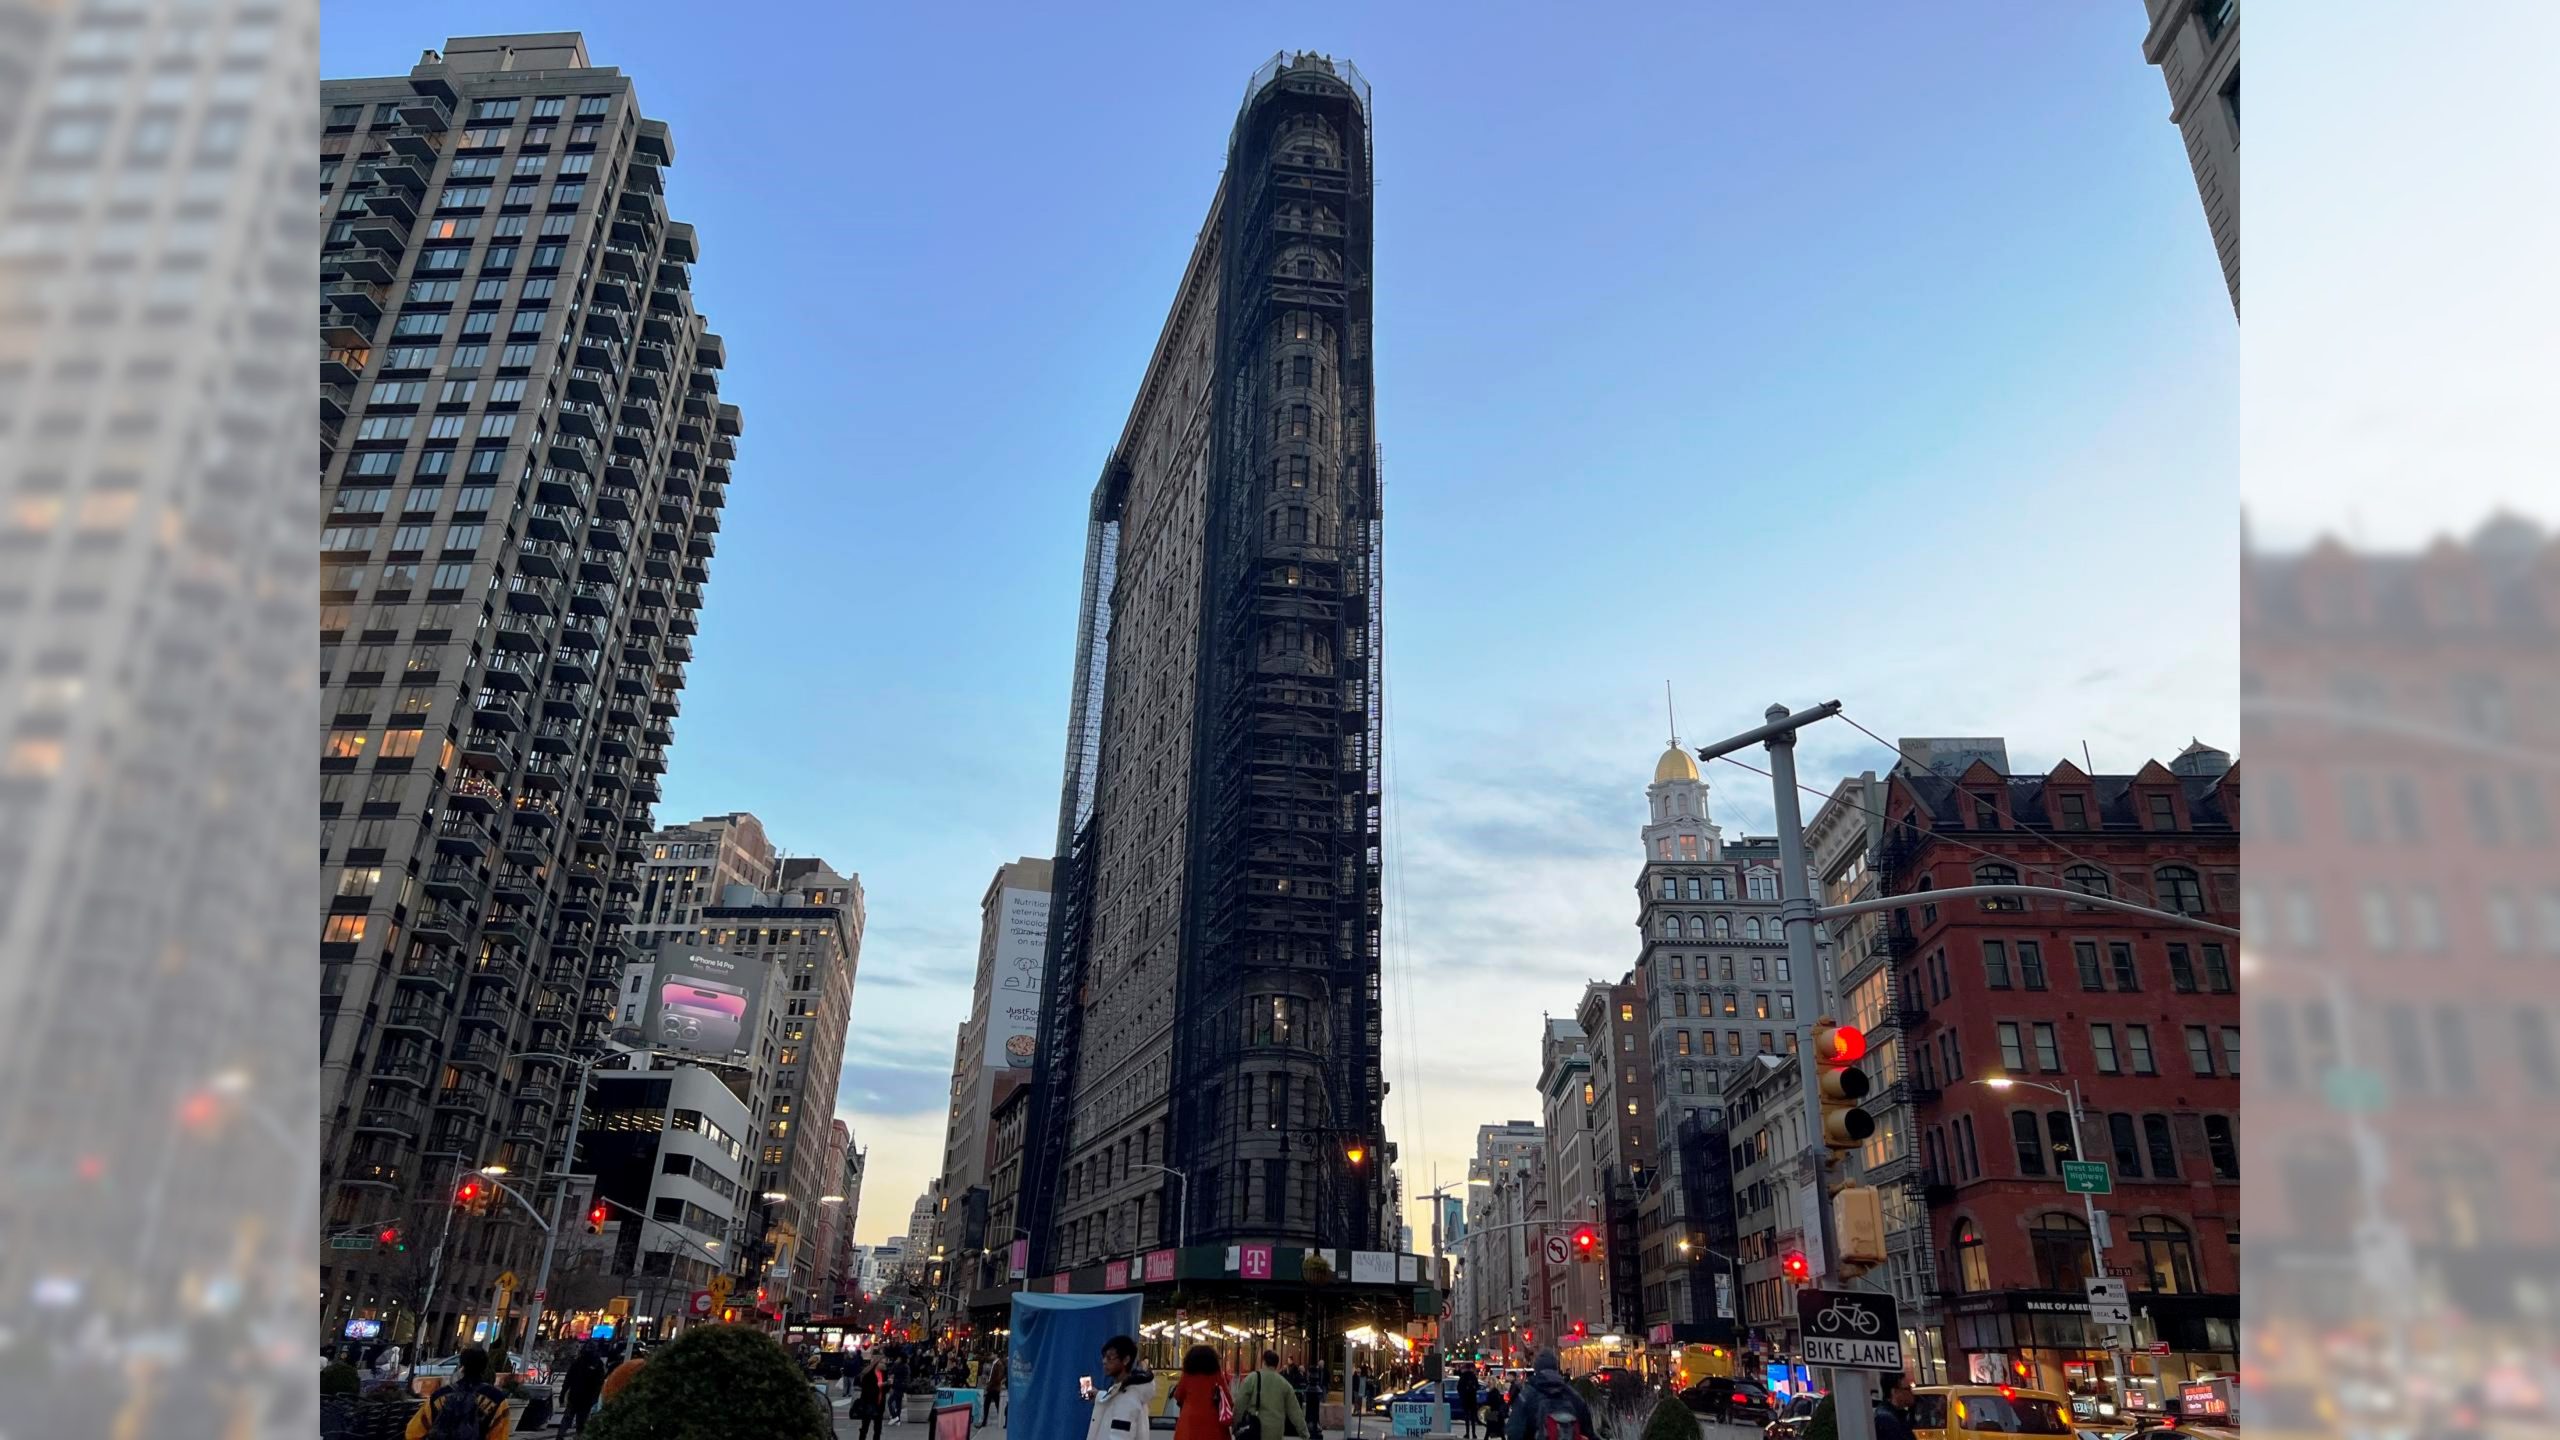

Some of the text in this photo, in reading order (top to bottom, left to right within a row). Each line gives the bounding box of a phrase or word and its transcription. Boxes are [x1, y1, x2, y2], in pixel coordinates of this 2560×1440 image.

[1014, 898, 1049, 908] Nutrition
[694, 955, 716, 966] iPhone
[723, 961, 735, 970] Pro
[2066, 1164, 2105, 1173] West Side
[2070, 1172, 2104, 1181] Highway
[2027, 1301, 2054, 1310] BANK
[2054, 1302, 2066, 1311] OF
[1806, 1340, 1898, 1364] BIKE LANE
[1394, 1404, 1408, 1413] THE
